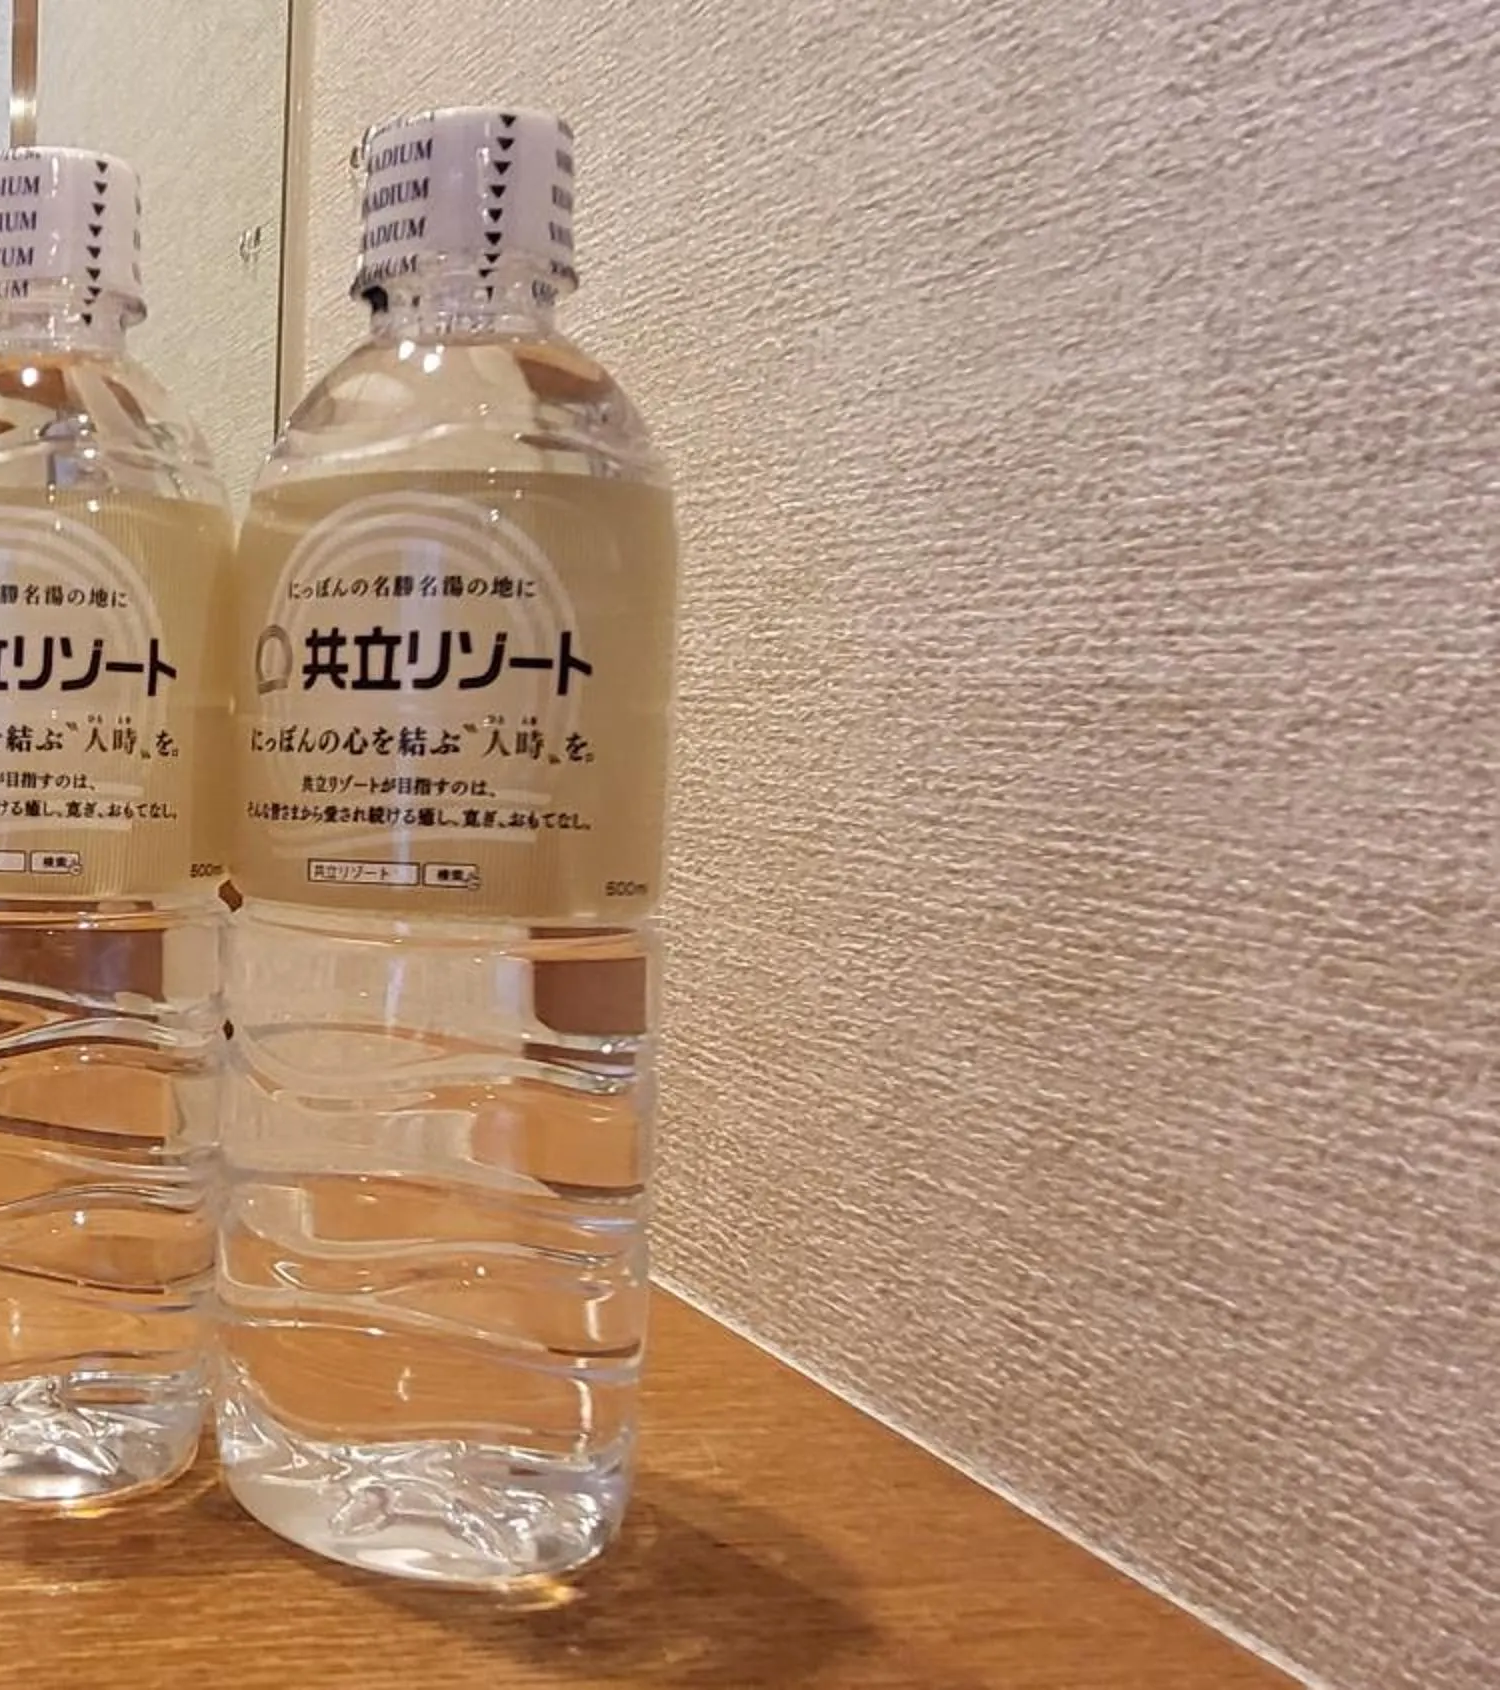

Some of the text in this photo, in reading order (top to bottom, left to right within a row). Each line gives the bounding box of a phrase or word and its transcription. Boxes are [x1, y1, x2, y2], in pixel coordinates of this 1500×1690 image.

[302, 625, 592, 696] 共立リゾート
[301, 774, 497, 798] 共立リゾートが目指すのは、
